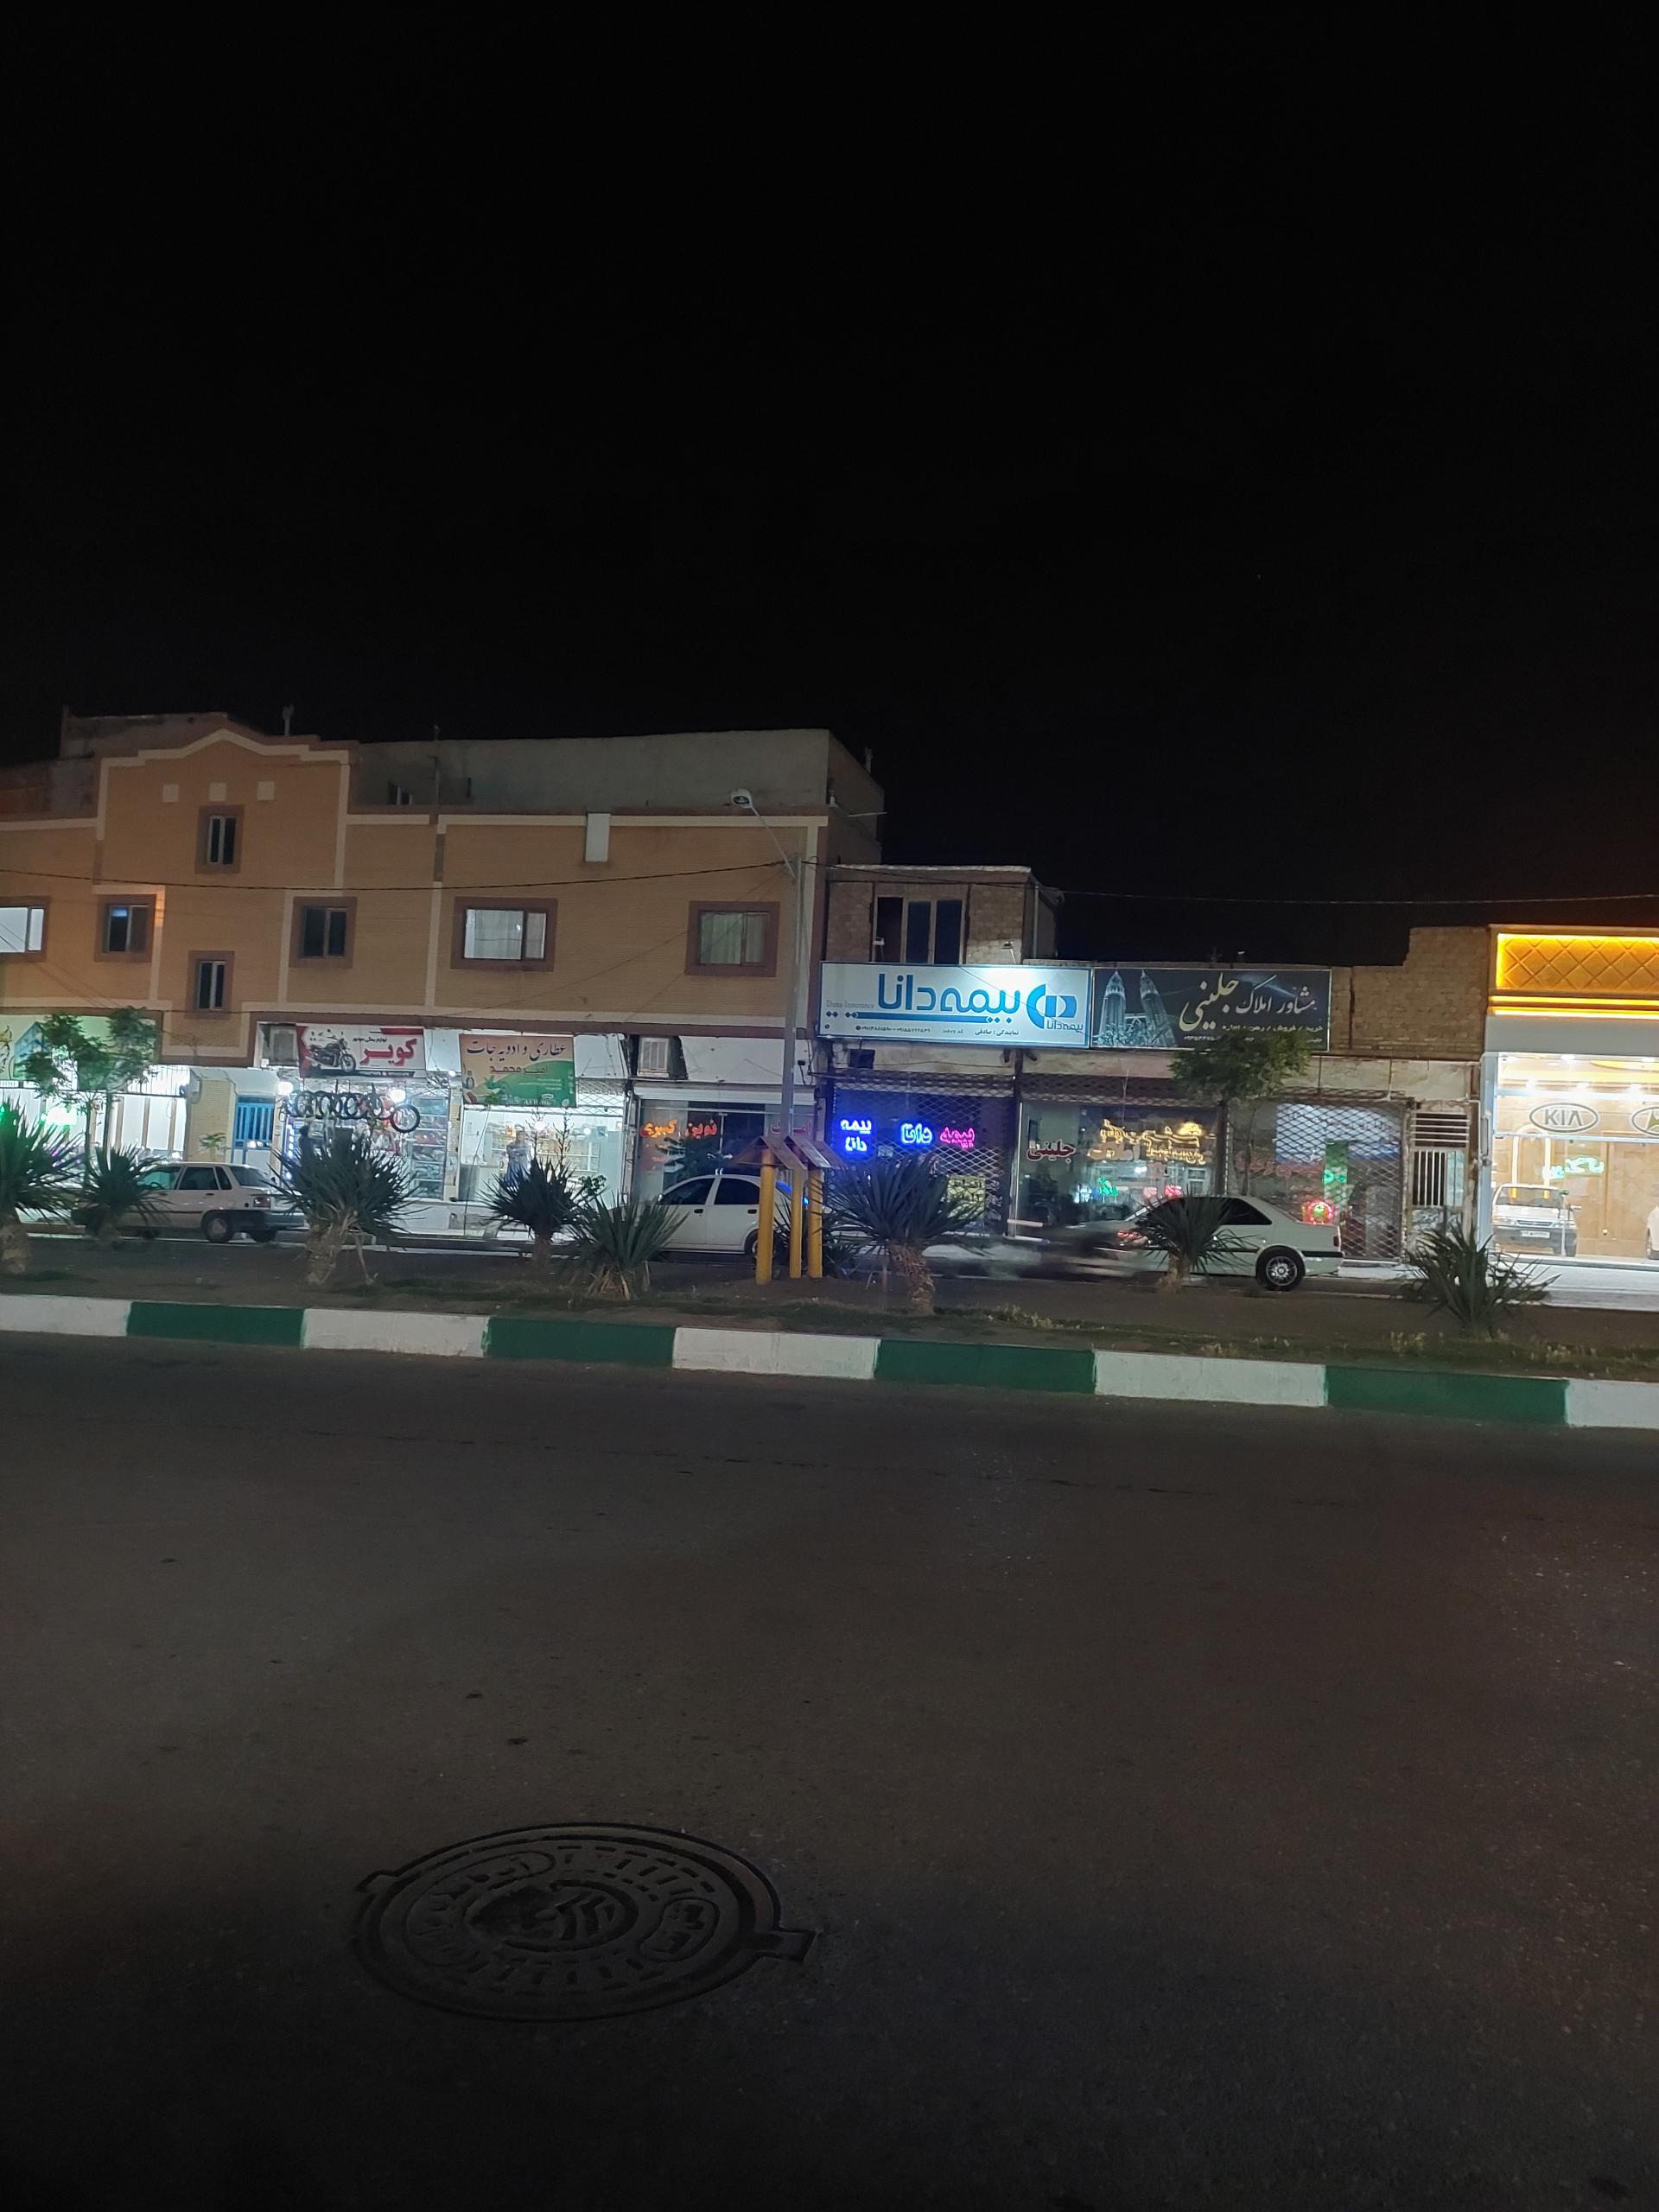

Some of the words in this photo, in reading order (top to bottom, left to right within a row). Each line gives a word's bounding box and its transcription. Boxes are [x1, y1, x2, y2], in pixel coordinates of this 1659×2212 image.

[878, 973, 937, 1010] دانا
[1179, 972, 1239, 1032] جلینی
[1236, 974, 1278, 1014] املاک
[1276, 986, 1316, 1014] مشاور
[939, 987, 1020, 1023] بیمه
[1047, 1020, 1064, 1030] دانا
[359, 1039, 417, 1066] کویر
[467, 1040, 498, 1062] جات
[499, 1043, 520, 1062] ادویه
[521, 1045, 528, 1055] و
[529, 1042, 567, 1061] عطاری
[489, 1065, 522, 1075] محمد
[841, 1118, 872, 1135] بیمه
[1544, 1109, 1583, 1127] KIA
[844, 1135, 868, 1152] دانا
[939, 1126, 976, 1148] بیمه
[1027, 1139, 1077, 1164] جلینی
